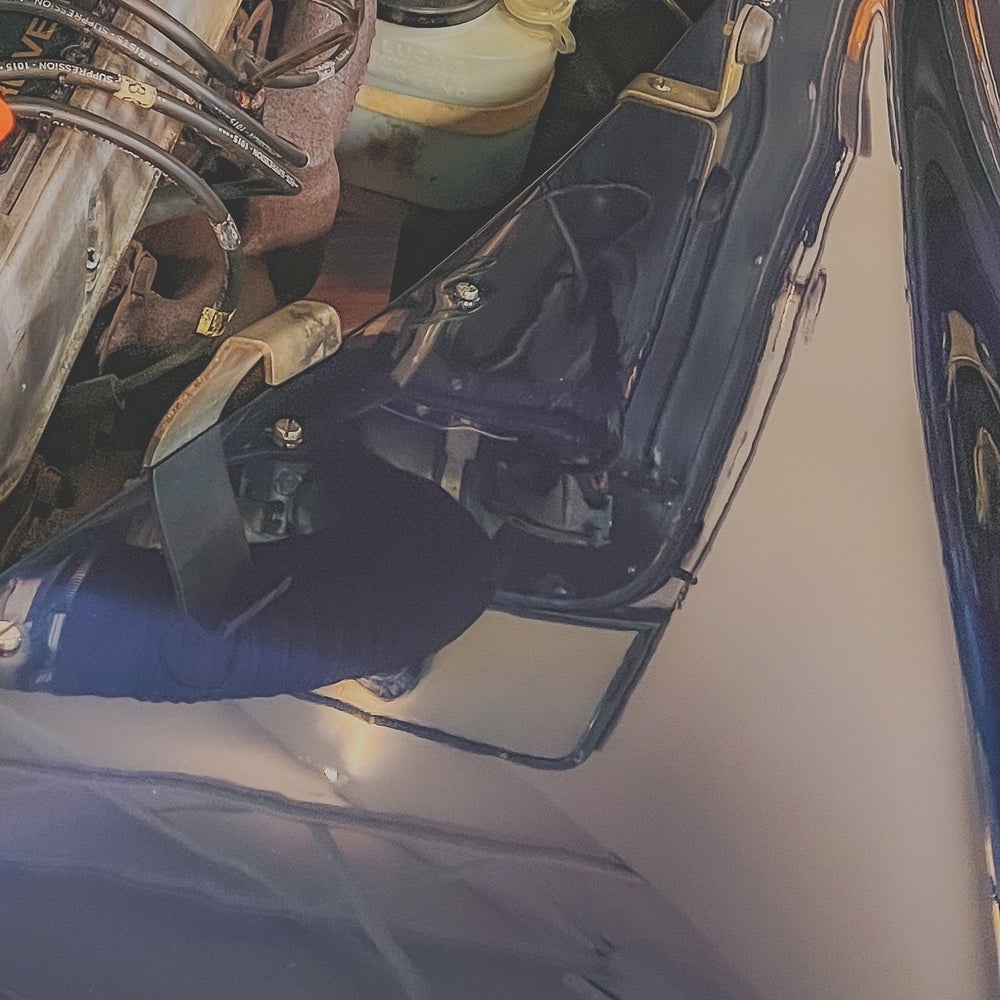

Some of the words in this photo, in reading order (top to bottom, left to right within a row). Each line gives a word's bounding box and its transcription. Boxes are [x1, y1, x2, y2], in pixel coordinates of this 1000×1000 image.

[116, 34, 148, 60] RISTS
[6, 61, 29, 72] 1015
[39, 61, 114, 83] SUPPRESSION
[232, 135, 249, 151] 1015
